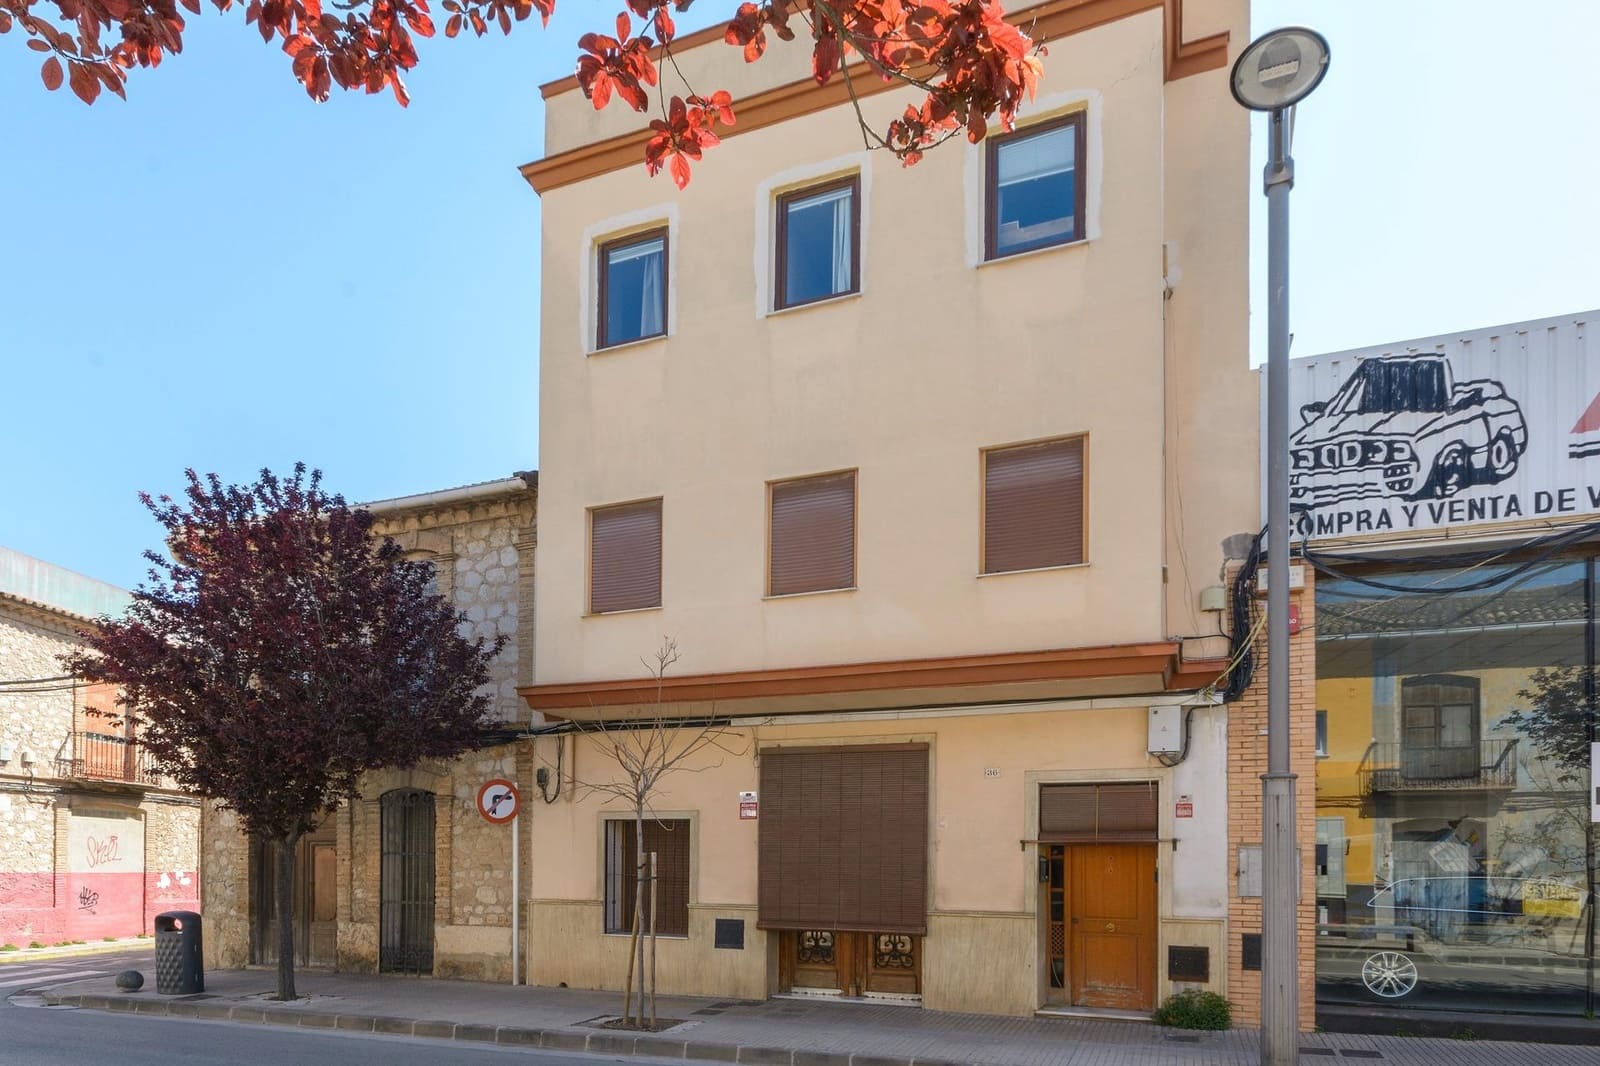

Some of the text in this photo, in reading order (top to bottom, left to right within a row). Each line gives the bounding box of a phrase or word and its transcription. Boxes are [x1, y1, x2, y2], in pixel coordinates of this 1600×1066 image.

[1290, 508, 1393, 536] OMPRA
[1401, 504, 1419, 527] Y
[1427, 494, 1522, 524] VENTA
[1534, 488, 1575, 514] DE
